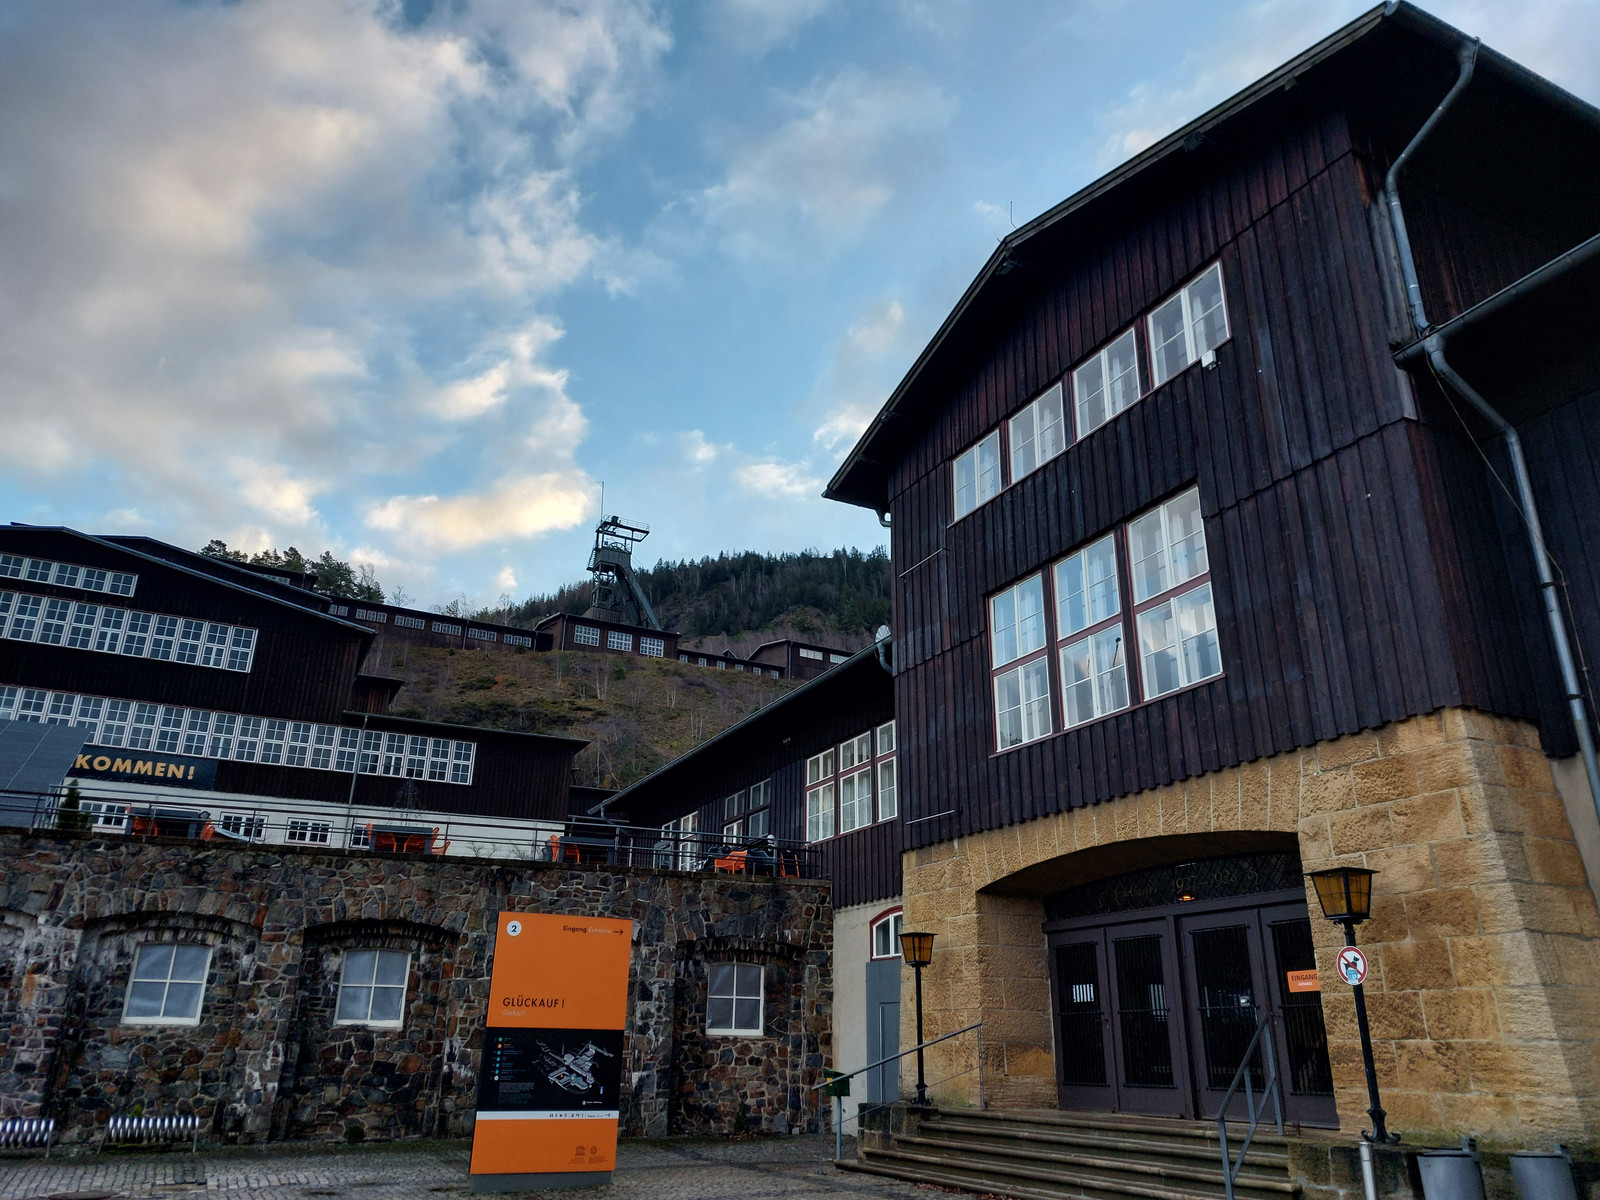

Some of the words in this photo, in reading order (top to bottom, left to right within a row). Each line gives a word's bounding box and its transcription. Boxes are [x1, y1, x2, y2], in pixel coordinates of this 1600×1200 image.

[75, 753, 196, 780] KOMMEN!
[511, 924, 517, 932] 2
[563, 925, 587, 933] Eingang
[1291, 973, 1318, 982] EINGANG
